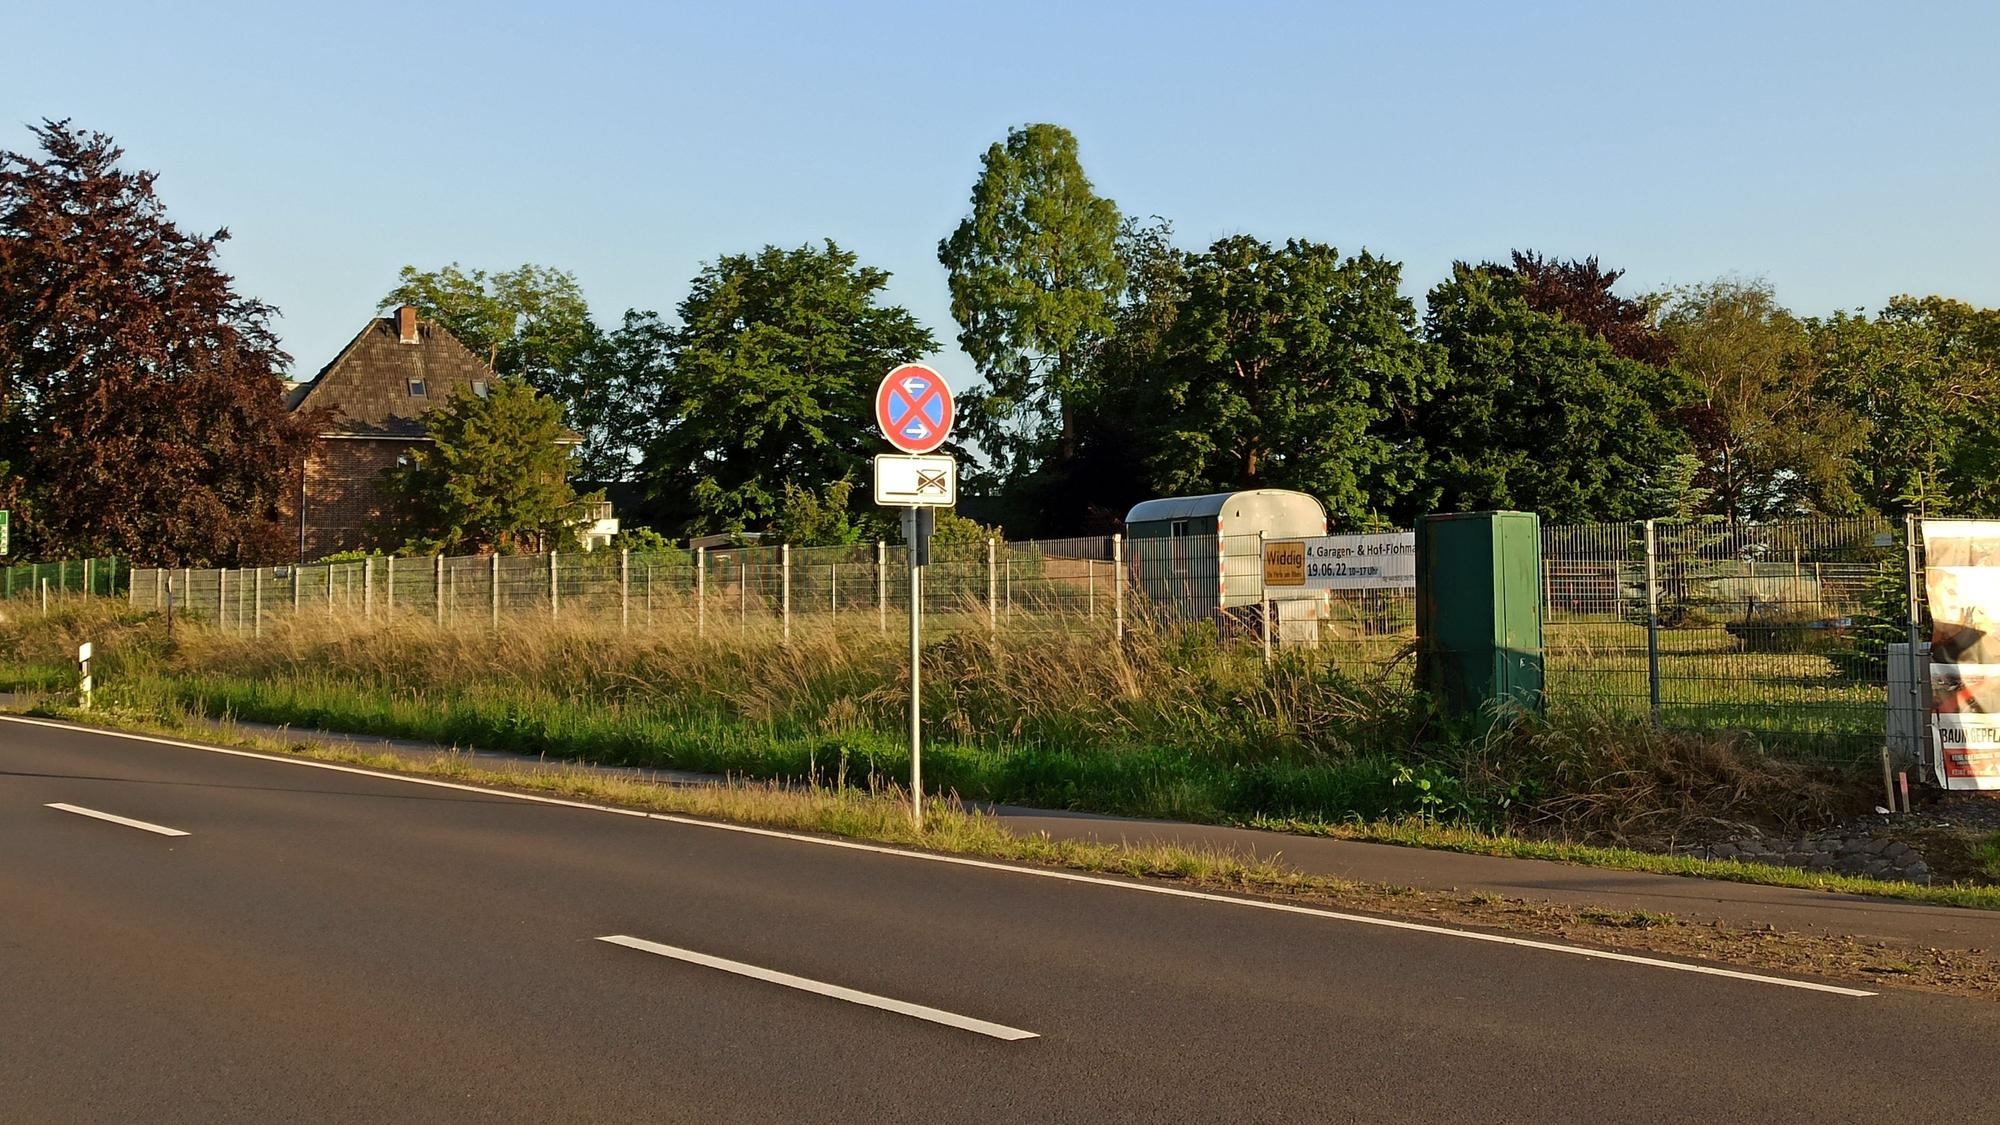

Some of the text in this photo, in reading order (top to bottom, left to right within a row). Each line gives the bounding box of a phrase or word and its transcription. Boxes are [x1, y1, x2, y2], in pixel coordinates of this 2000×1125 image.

[1267, 550, 1302, 568] Widdig
[1307, 547, 1314, 557] 4.
[1317, 546, 1354, 559] Garagen-
[1357, 545, 1364, 555] &
[1307, 563, 1347, 576] 19.06.22
[1368, 566, 1378, 575] Uhr
[1971, 728, 2000, 743] GEPFL
